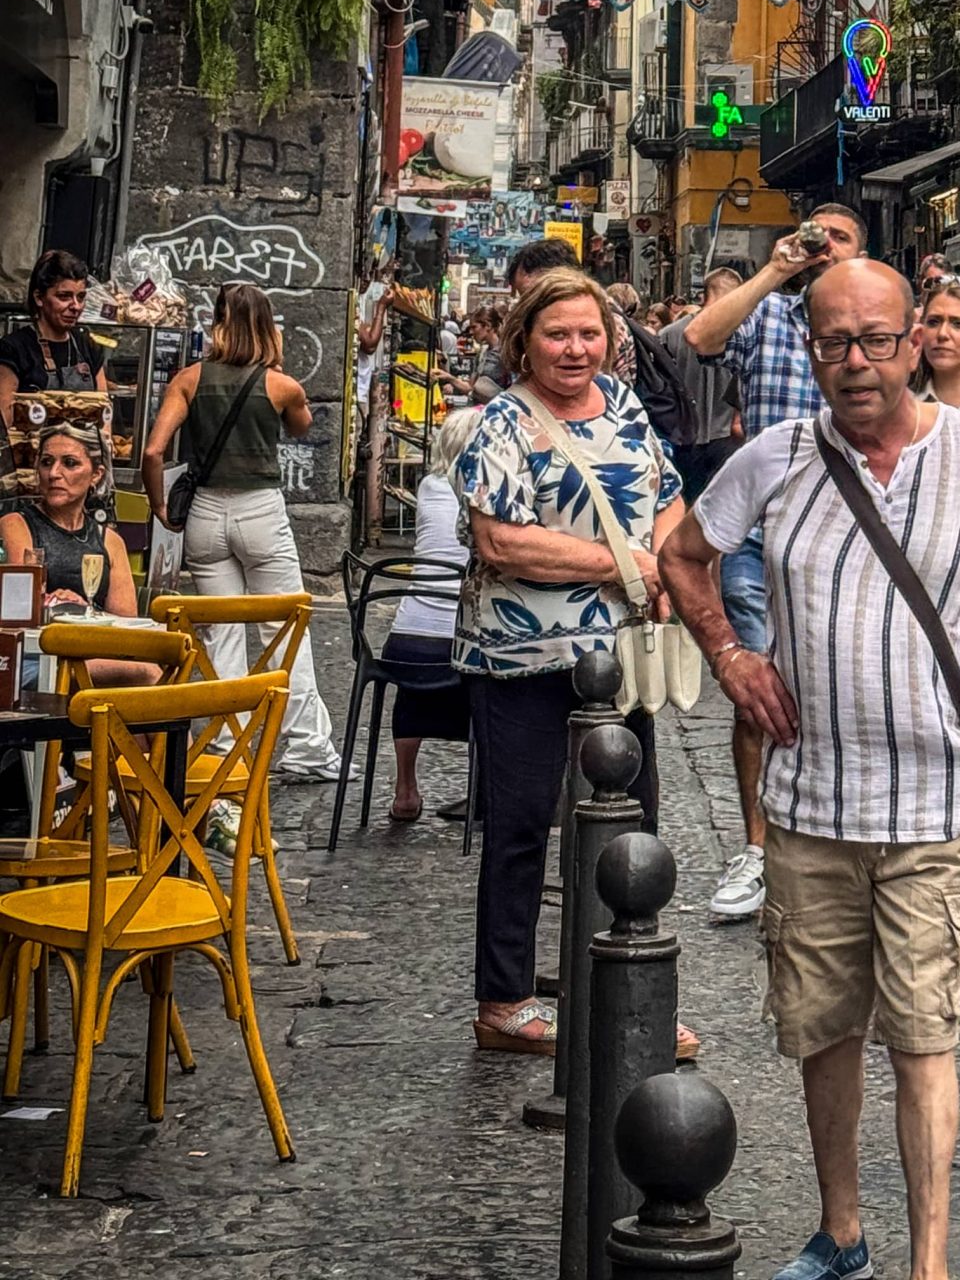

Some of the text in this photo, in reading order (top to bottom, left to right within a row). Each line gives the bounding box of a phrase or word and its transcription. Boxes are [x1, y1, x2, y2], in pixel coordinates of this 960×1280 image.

[405, 106, 485, 118] MOZZARELLA CHEESE
[843, 106, 891, 118] VALENTI
